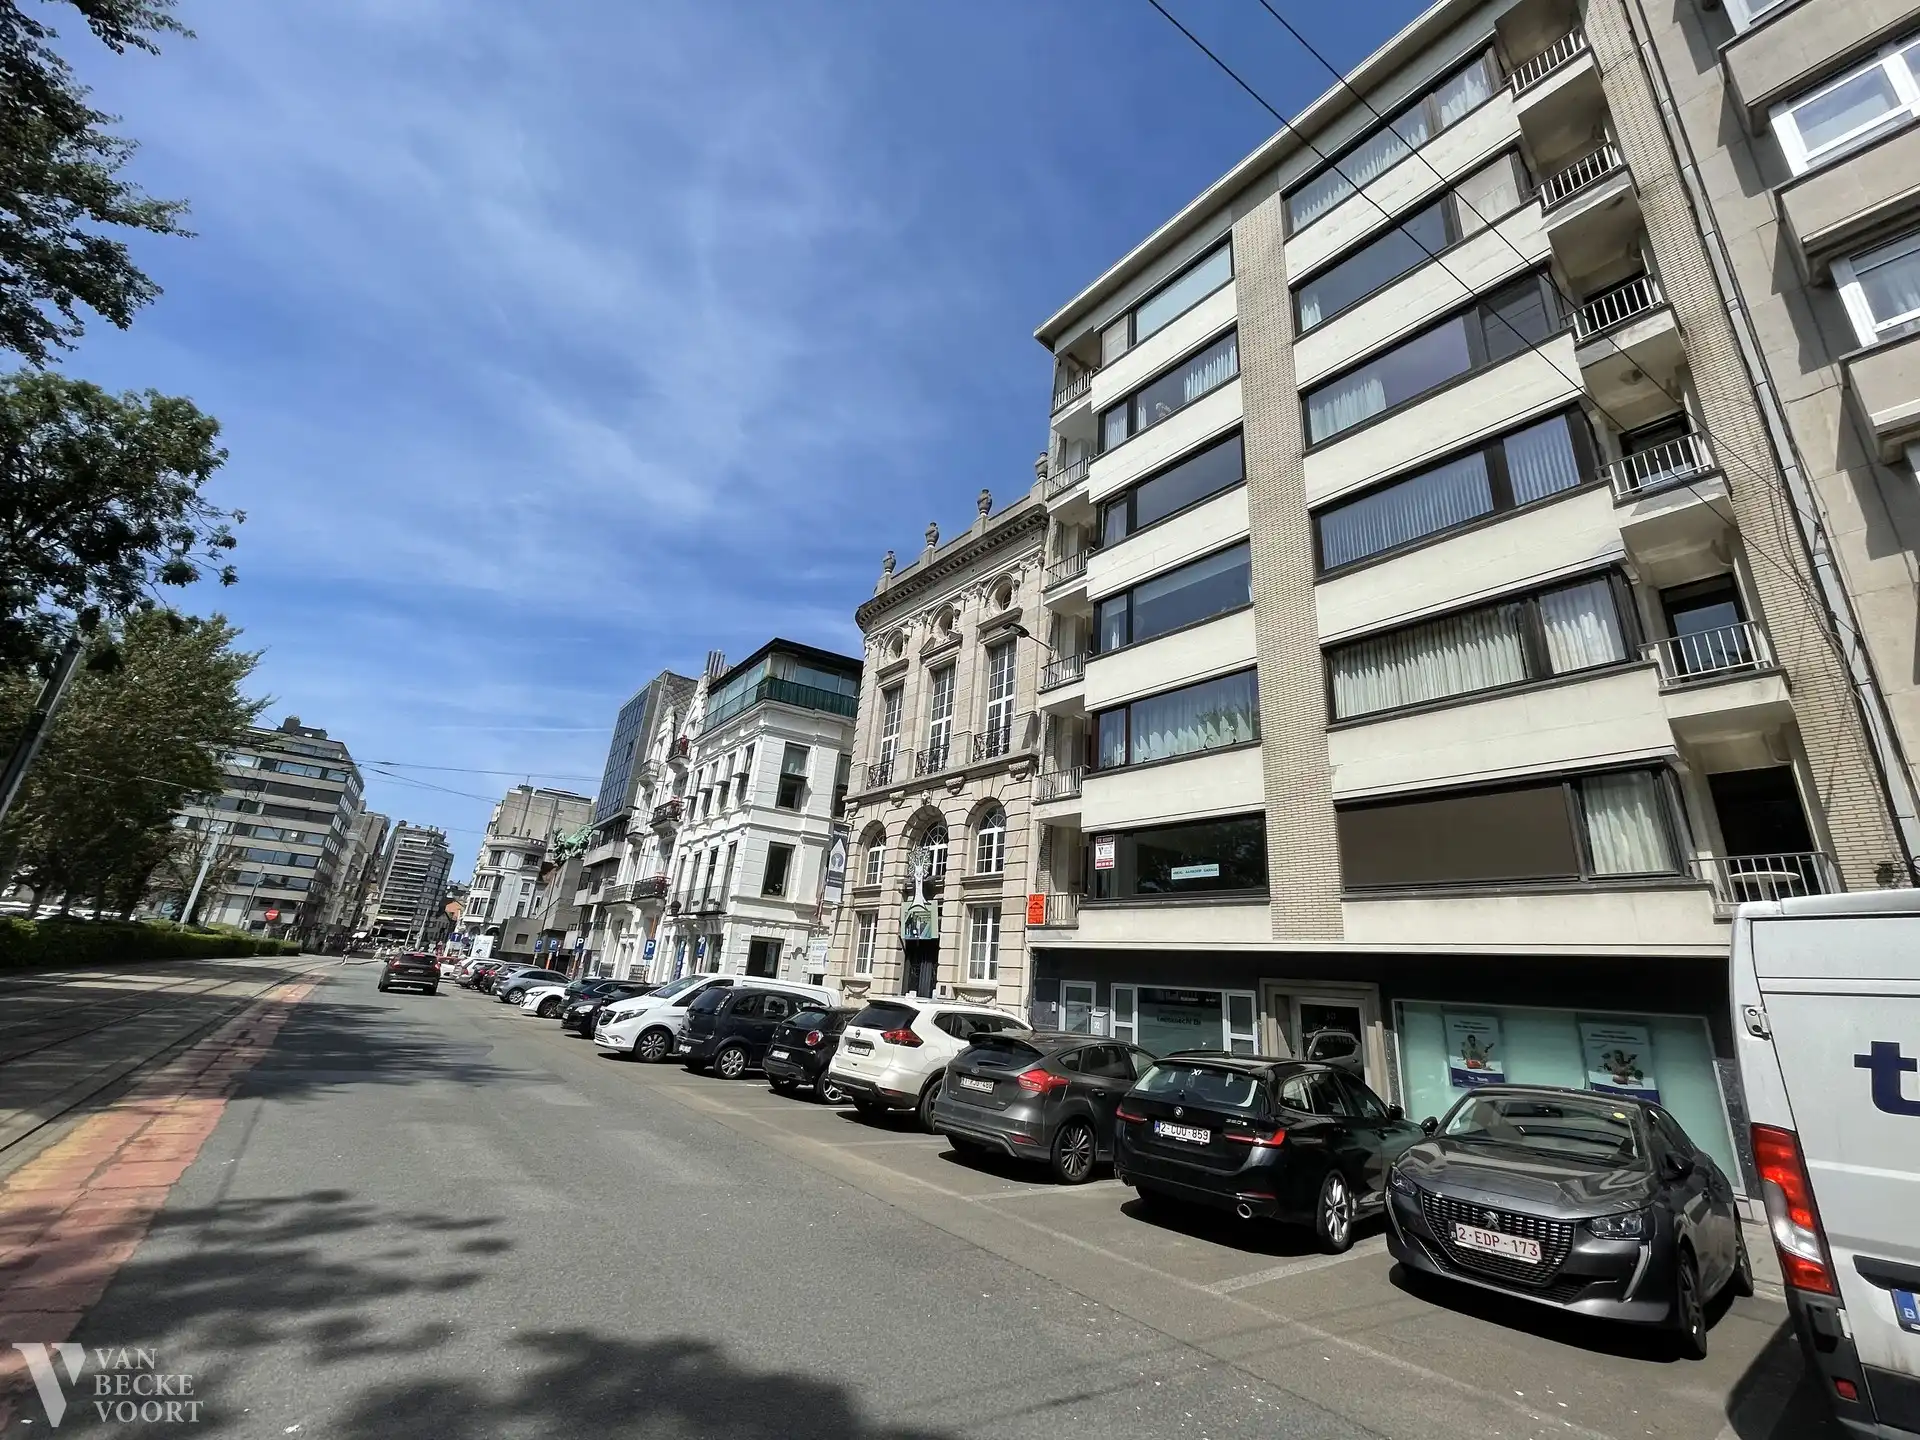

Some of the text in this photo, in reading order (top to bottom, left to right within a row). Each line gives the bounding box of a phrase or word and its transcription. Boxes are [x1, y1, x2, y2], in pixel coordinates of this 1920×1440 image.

[645, 941, 654, 952] P
[1458, 1226, 1538, 1257] 2-EDP-173
[1903, 1307, 1916, 1319] B
